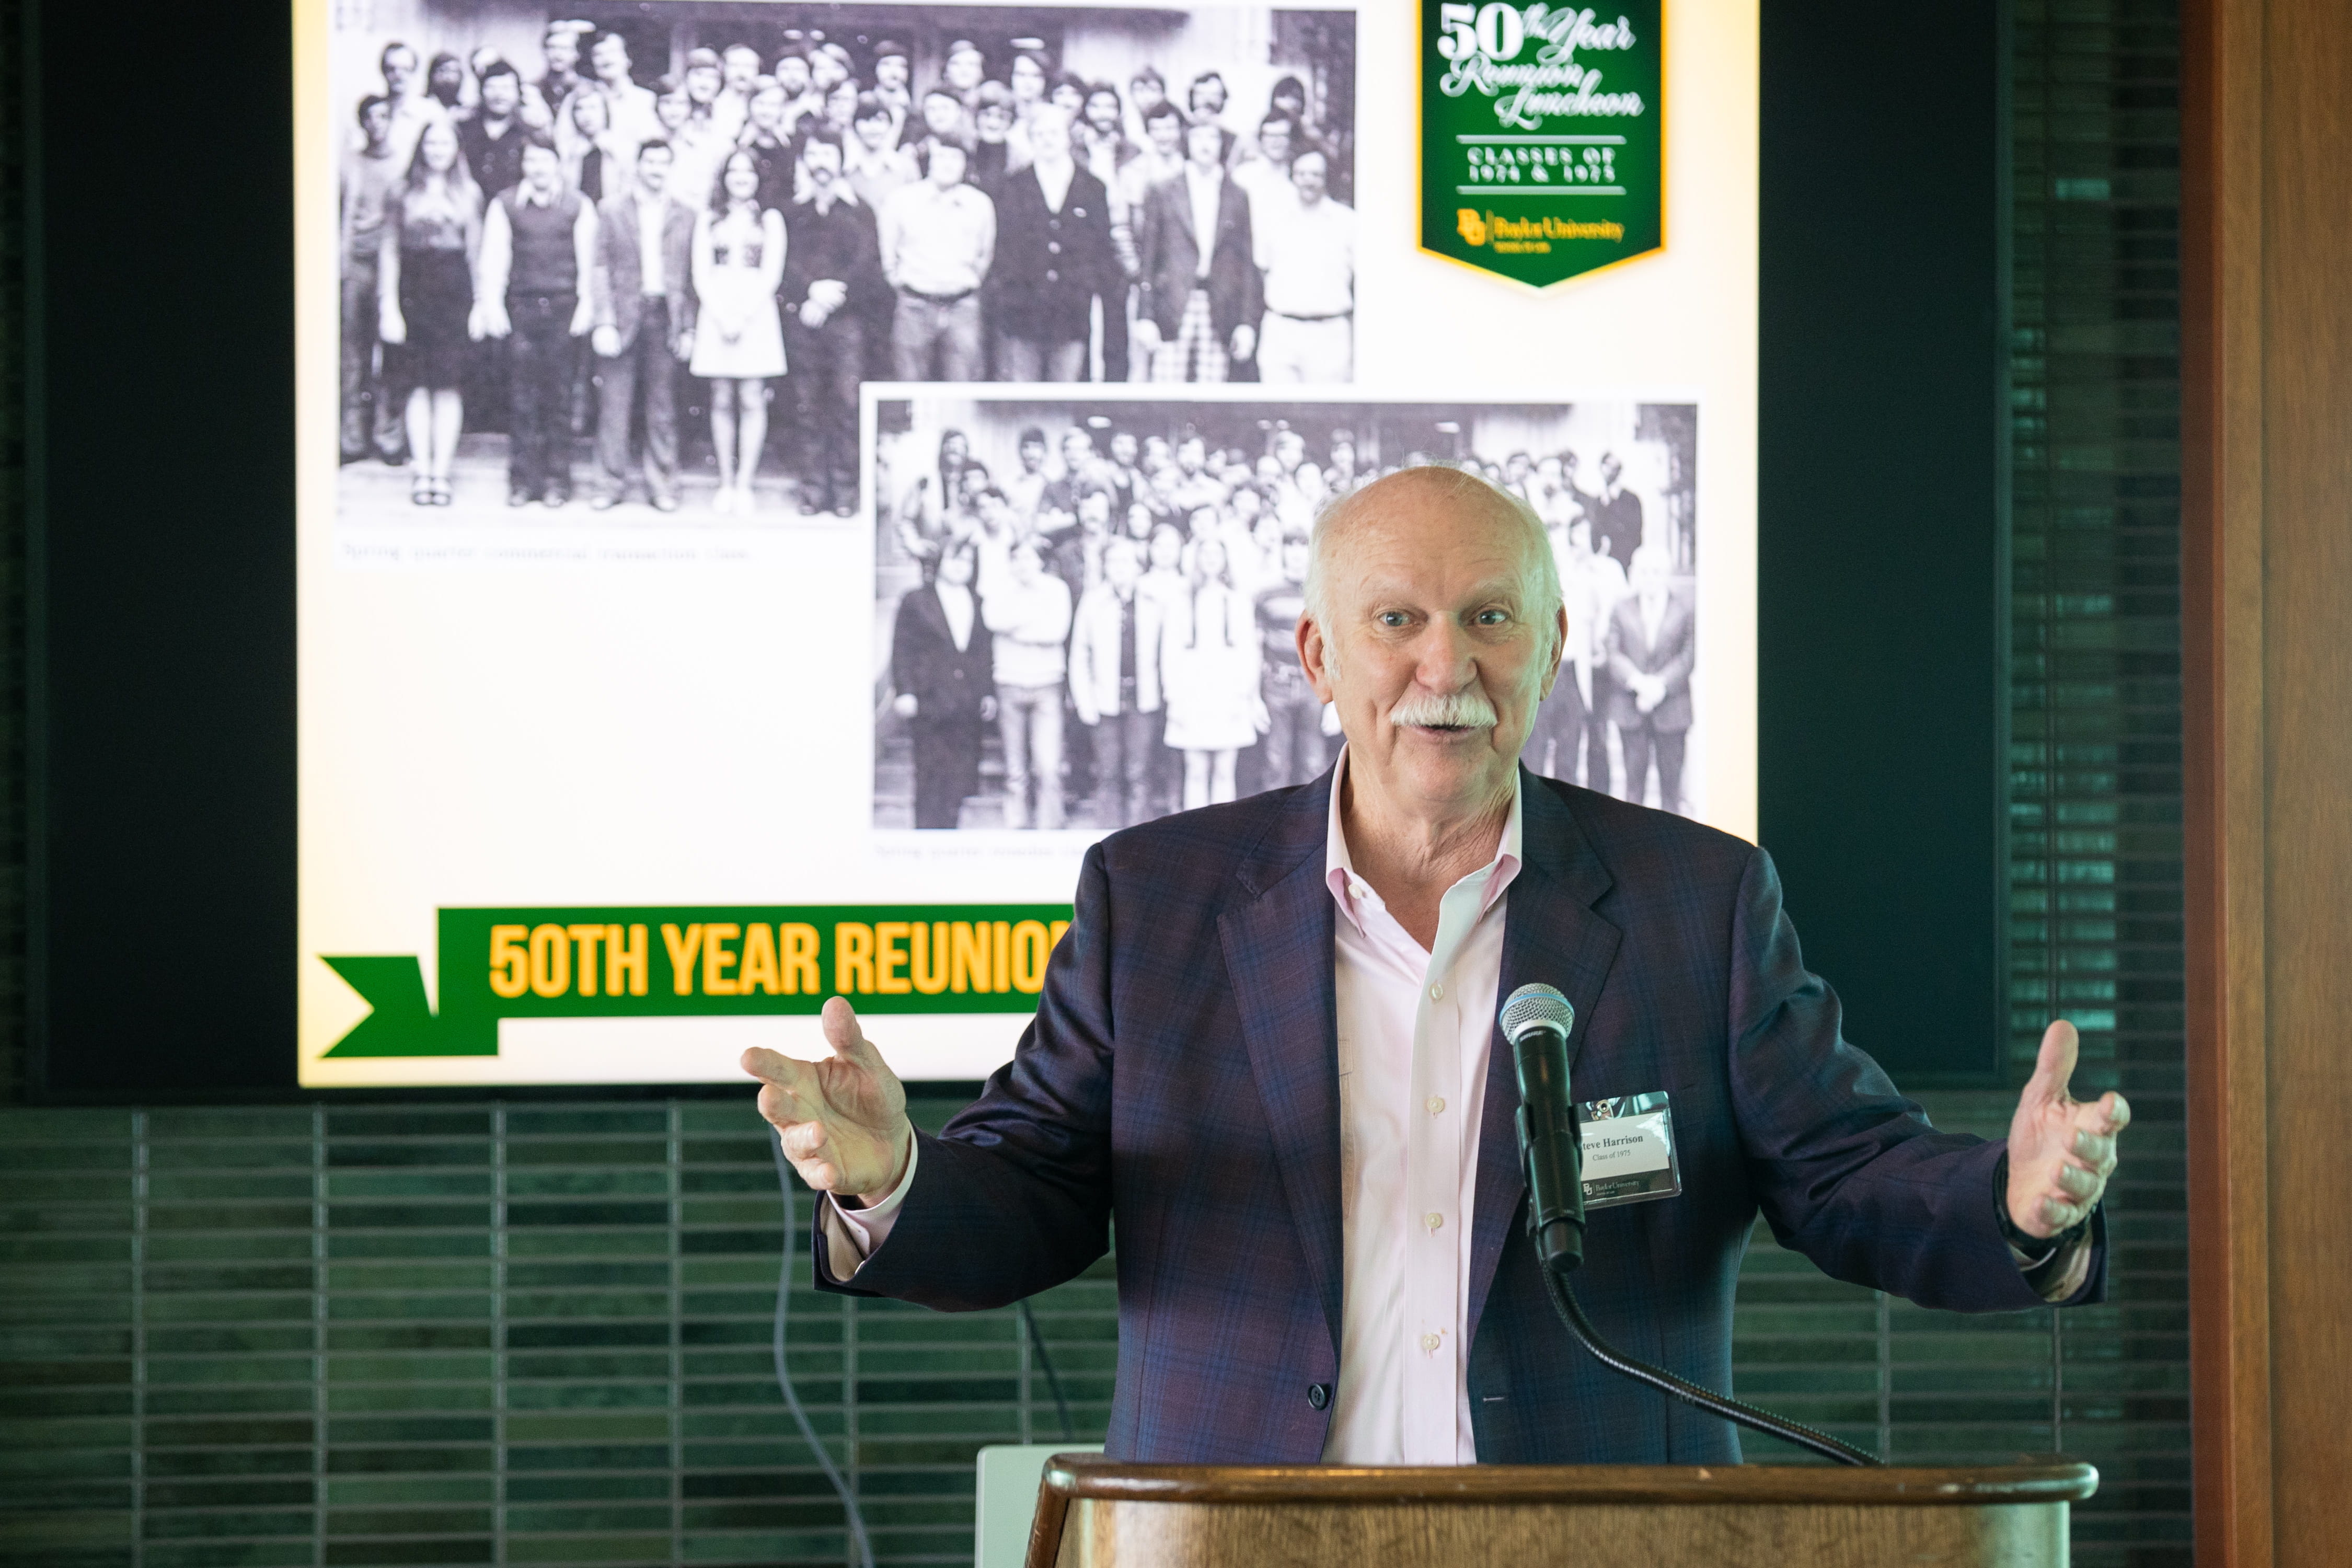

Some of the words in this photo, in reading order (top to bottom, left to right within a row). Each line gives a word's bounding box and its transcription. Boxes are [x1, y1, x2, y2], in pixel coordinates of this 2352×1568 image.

[1536, 7, 1636, 64] Year
[1494, 68, 1645, 130] Luncheon
[1467, 147, 1573, 166] CLASSES
[489, 923, 649, 998] 50TH
[661, 923, 821, 996] YEAR
[835, 920, 1073, 995] REUNIO
[1583, 1142, 1600, 1150] teve
[1603, 1135, 1643, 1148] Harrison
